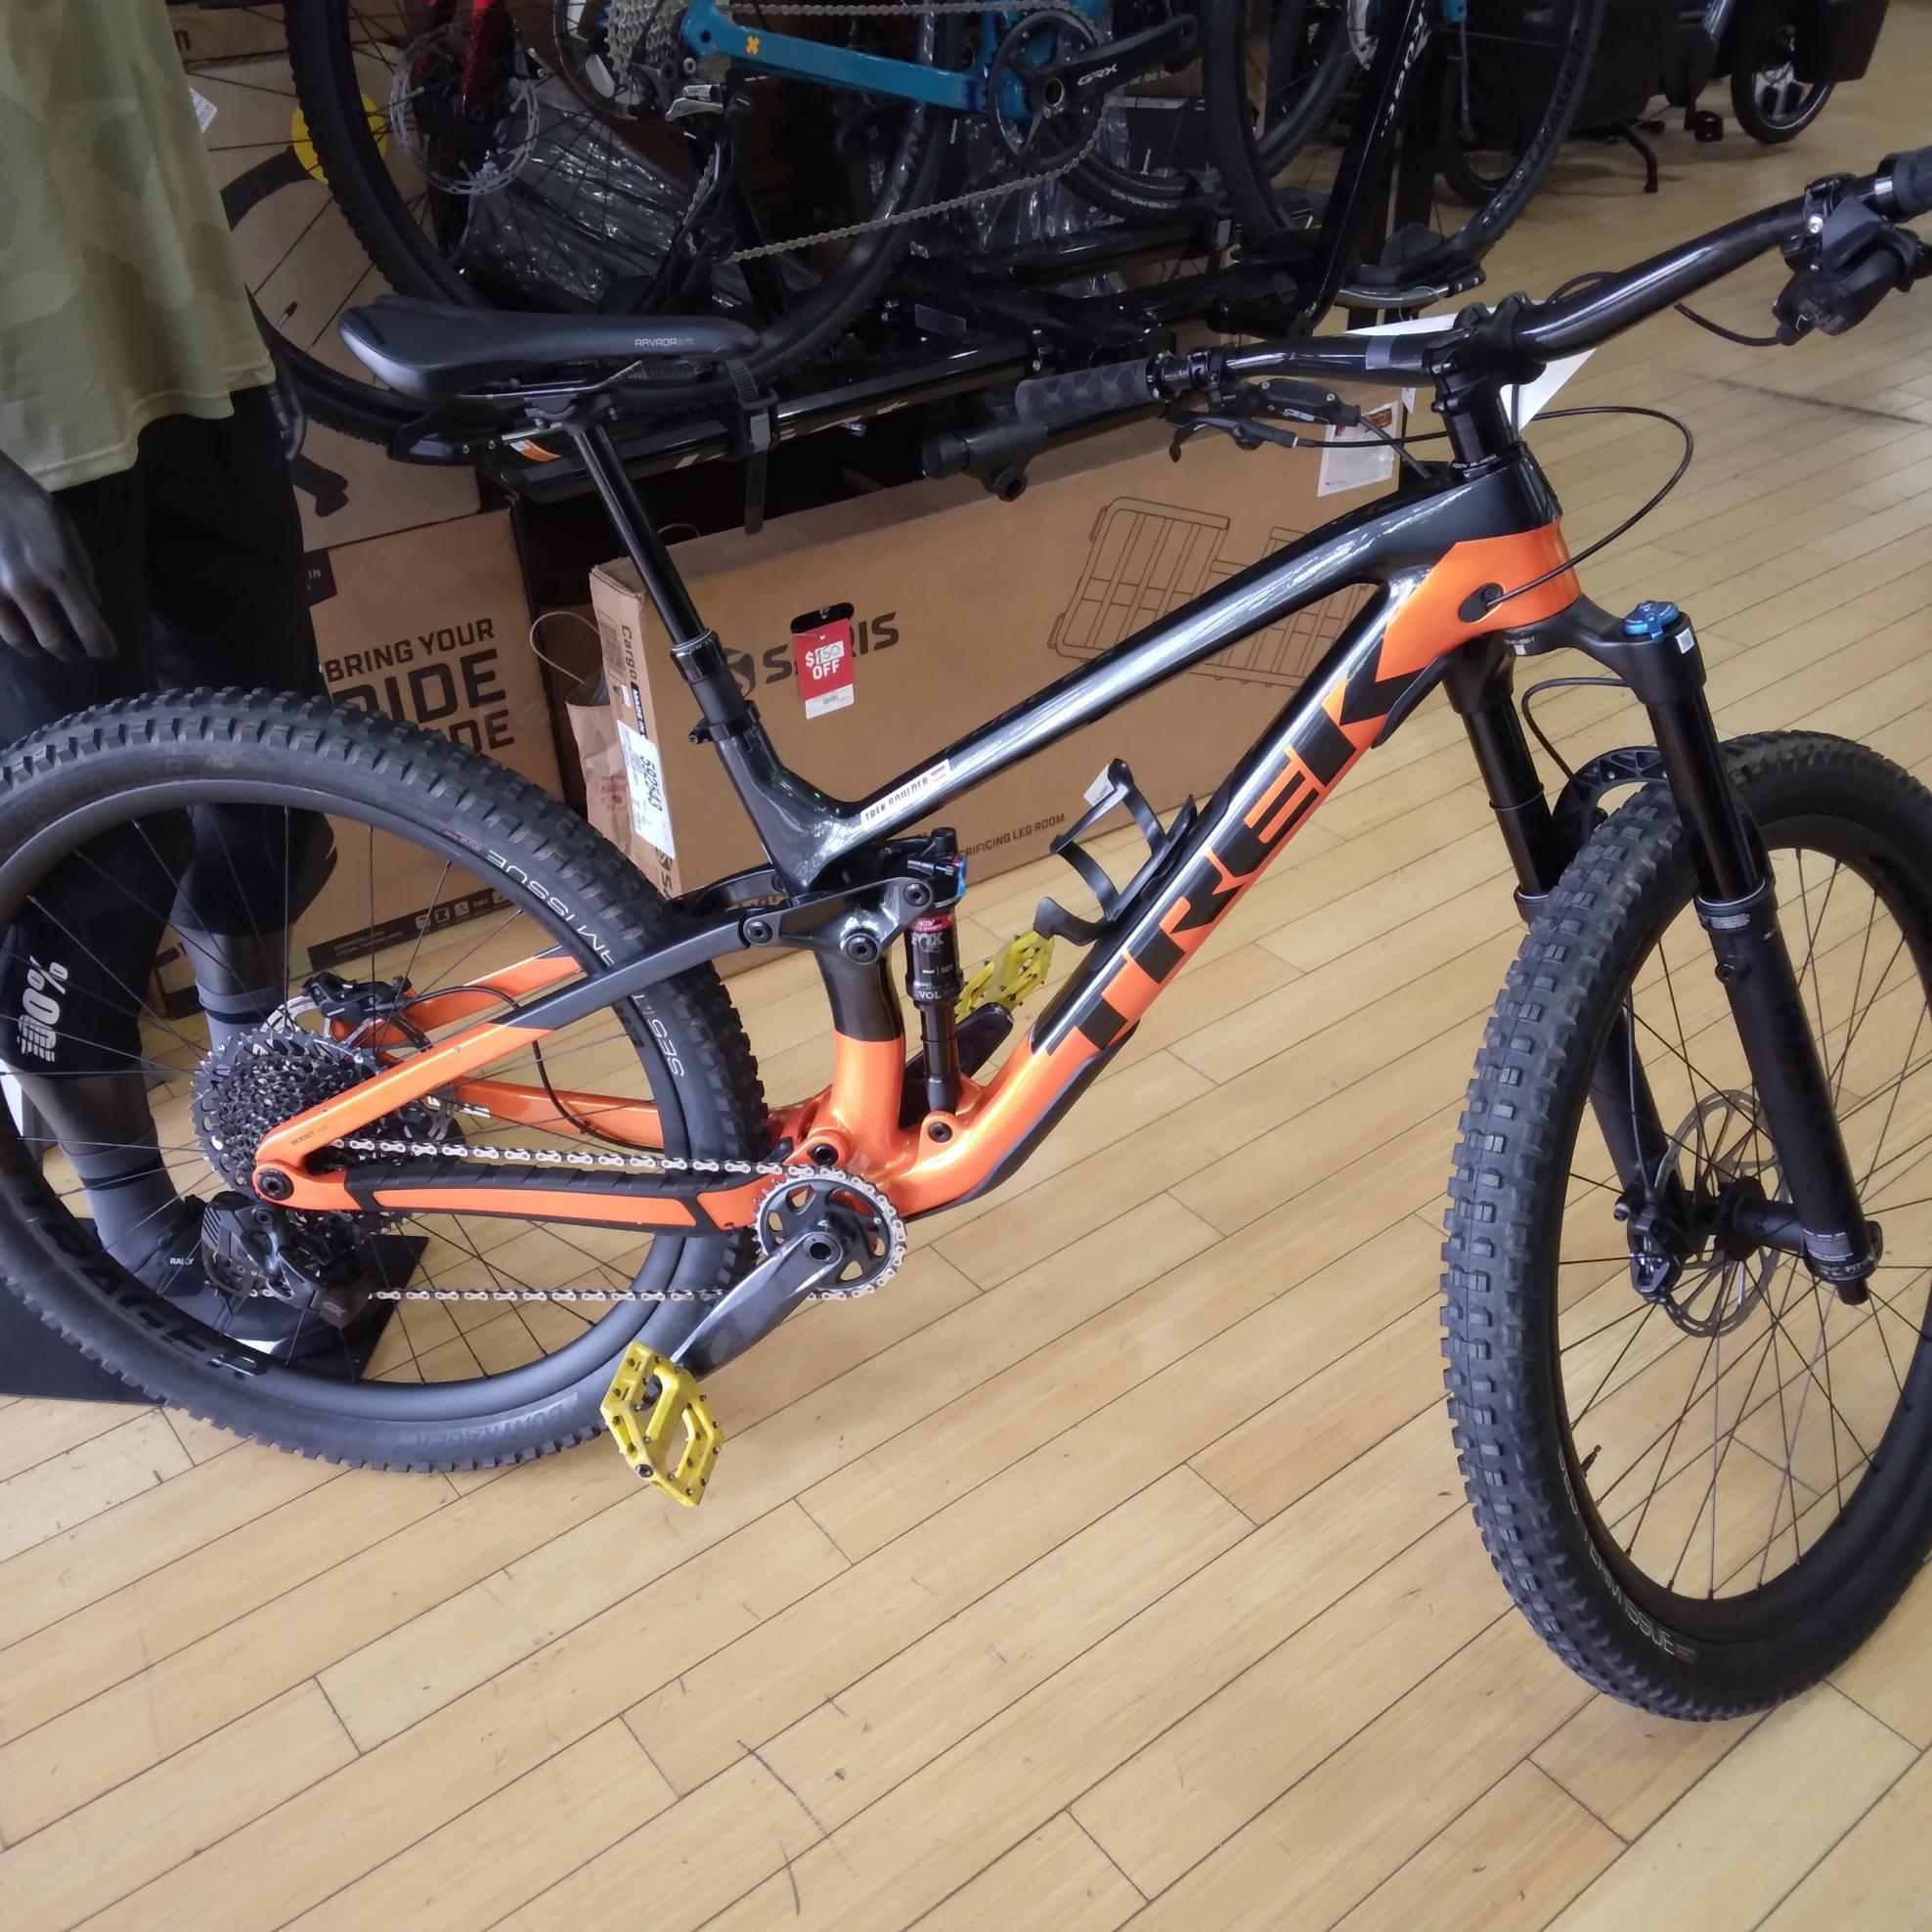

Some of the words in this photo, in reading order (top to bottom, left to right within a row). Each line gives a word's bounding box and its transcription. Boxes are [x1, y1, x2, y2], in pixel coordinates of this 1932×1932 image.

[1077, 64, 1118, 86] GRX
[635, 337, 677, 347] ARVADA
[324, 639, 414, 682] BRING
[417, 618, 495, 656] YOUR
[621, 624, 638, 681] Cargo
[763, 612, 900, 685] SIS
[812, 659, 840, 681] OFF
[639, 755, 663, 812] 592543
[959, 833, 1011, 856] CRIFICING
[1013, 824, 1032, 840] LEG
[1048, 619, 1430, 1054] TREK
[487, 849, 576, 922] ISSUE
[910, 932, 944, 953] FOX
[1623, 1593, 1676, 1657] ISSUE
